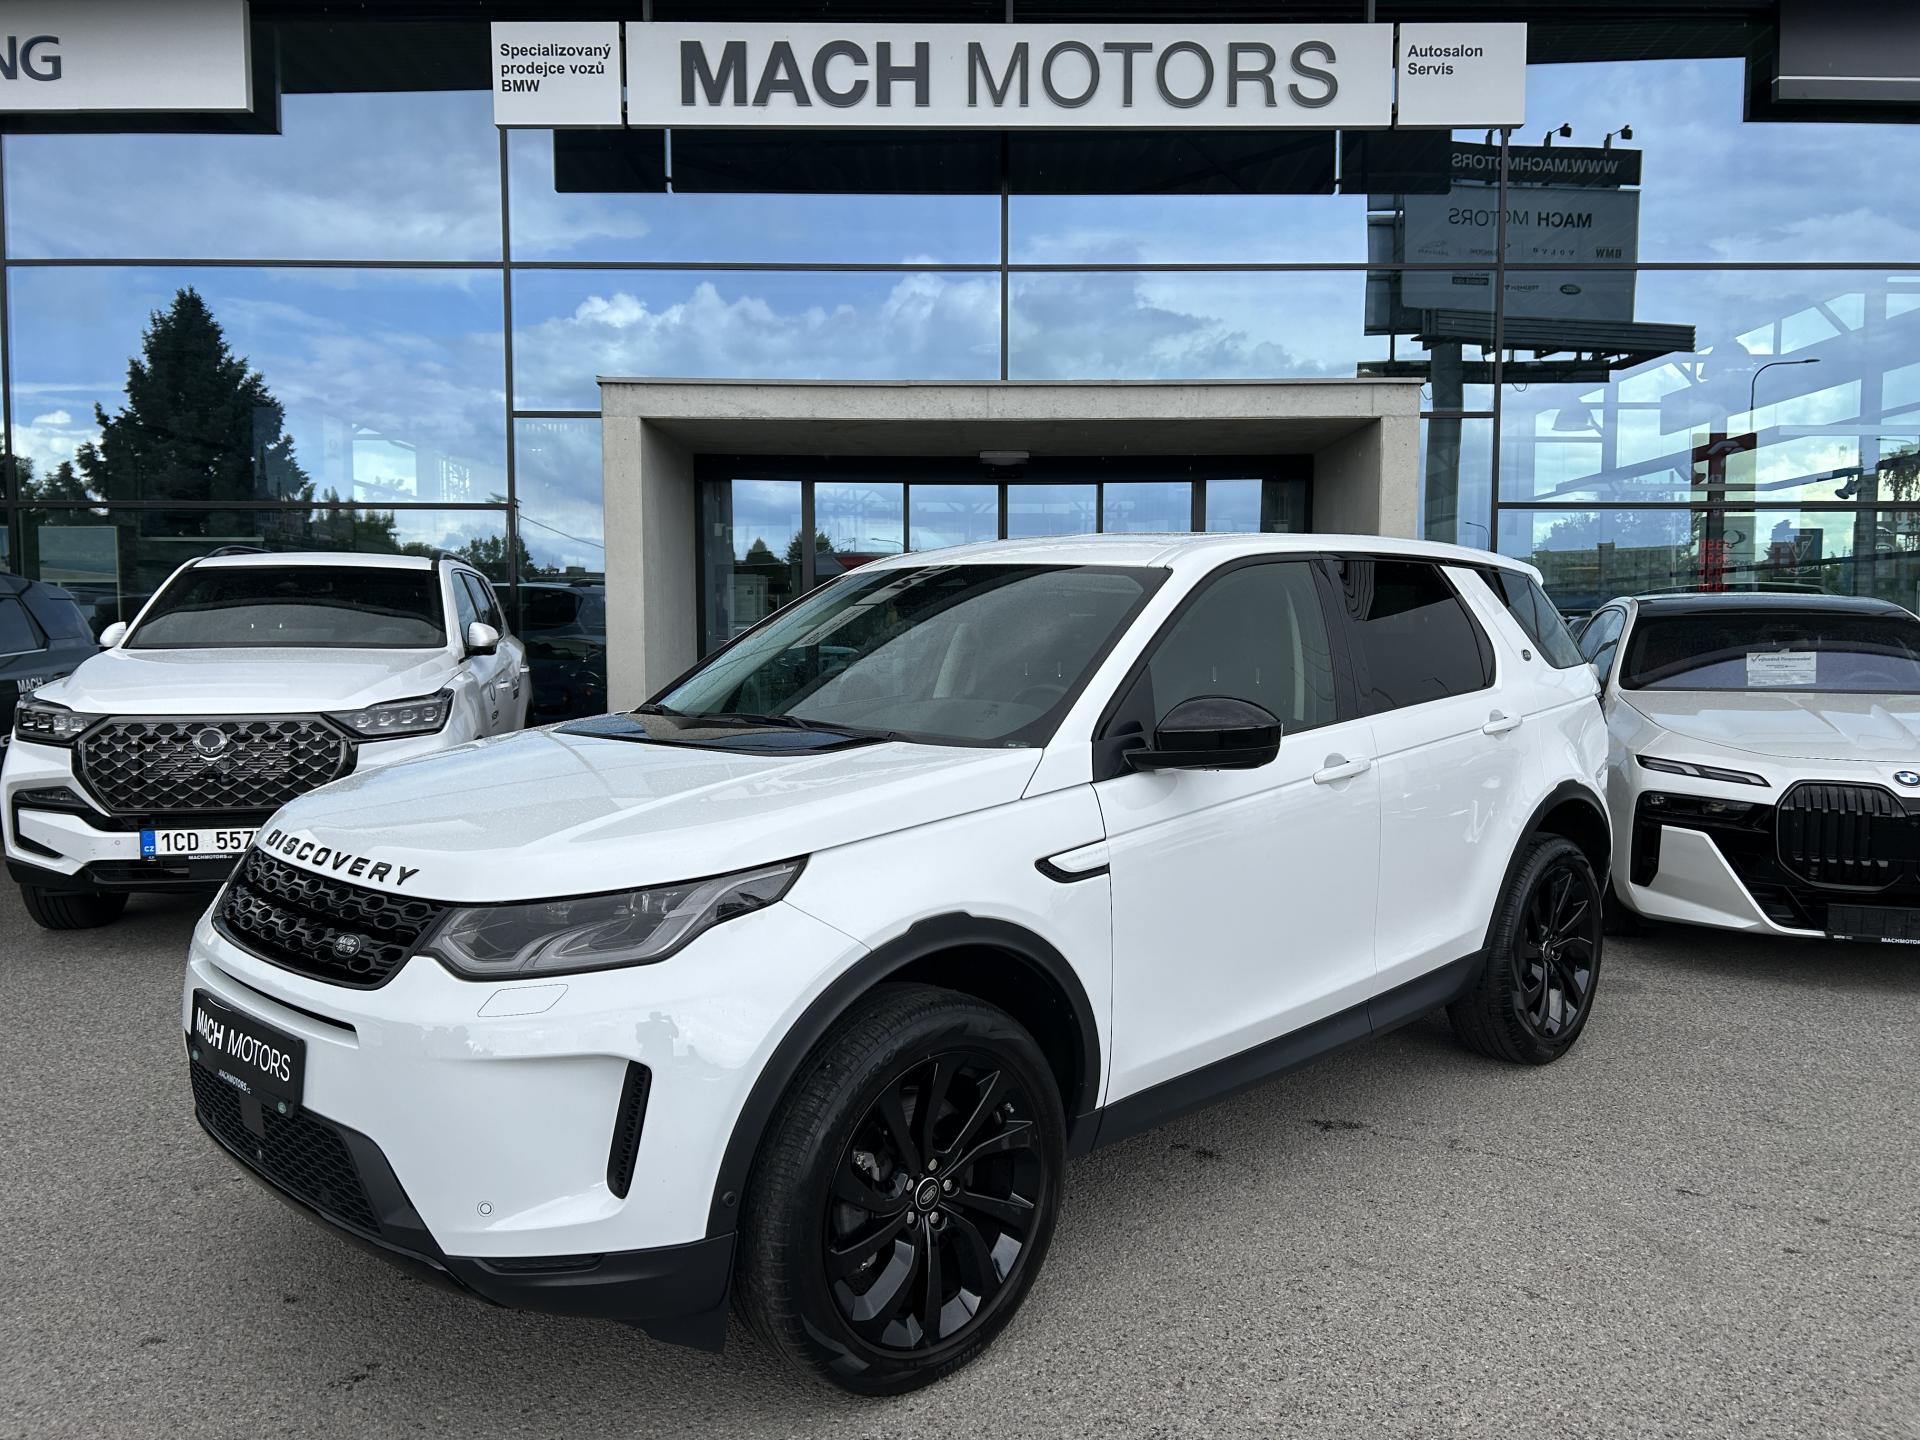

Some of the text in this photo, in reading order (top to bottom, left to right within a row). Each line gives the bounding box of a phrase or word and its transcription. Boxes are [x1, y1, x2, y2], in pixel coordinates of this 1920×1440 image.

[500, 43, 611, 59] Specializovaný
[1407, 44, 1484, 58] Autosalon
[501, 61, 605, 77] prodejce vozů
[680, 40, 1339, 109] MACH MOTORS
[1407, 62, 1454, 76] Servis
[501, 79, 540, 93] BMW
[17, 677, 43, 693] MACH
[161, 830, 259, 852] 1CD 557
[265, 828, 420, 886] DISCOVERY
[196, 1007, 291, 1082] MACH MOTORS
